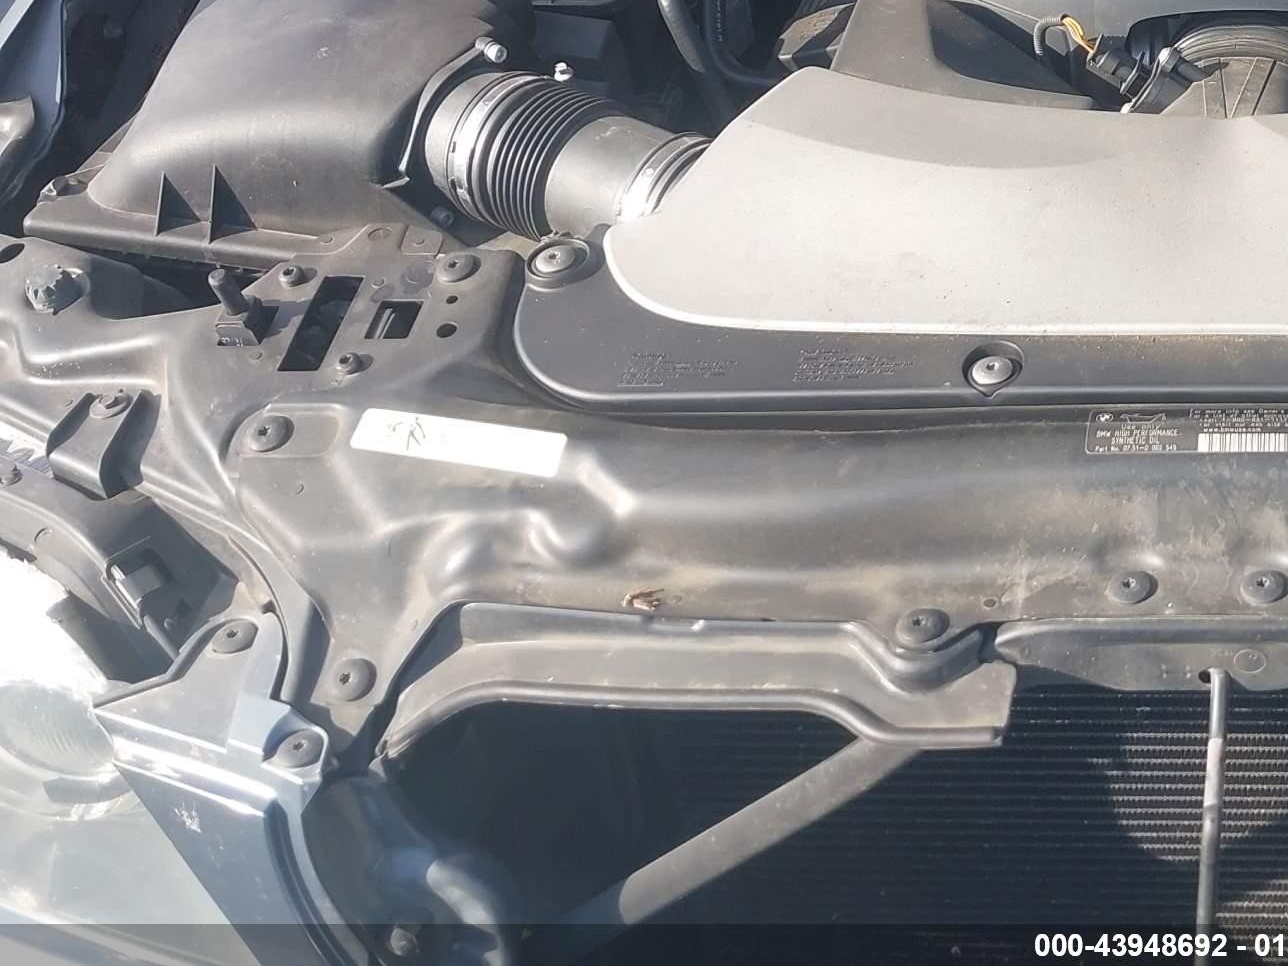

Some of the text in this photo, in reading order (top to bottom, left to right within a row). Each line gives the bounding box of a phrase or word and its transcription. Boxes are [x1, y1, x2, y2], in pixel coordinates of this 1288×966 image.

[1133, 429, 1179, 437] PERFORMANCE
[1111, 436, 1160, 444] SYNTHETIC OIL
